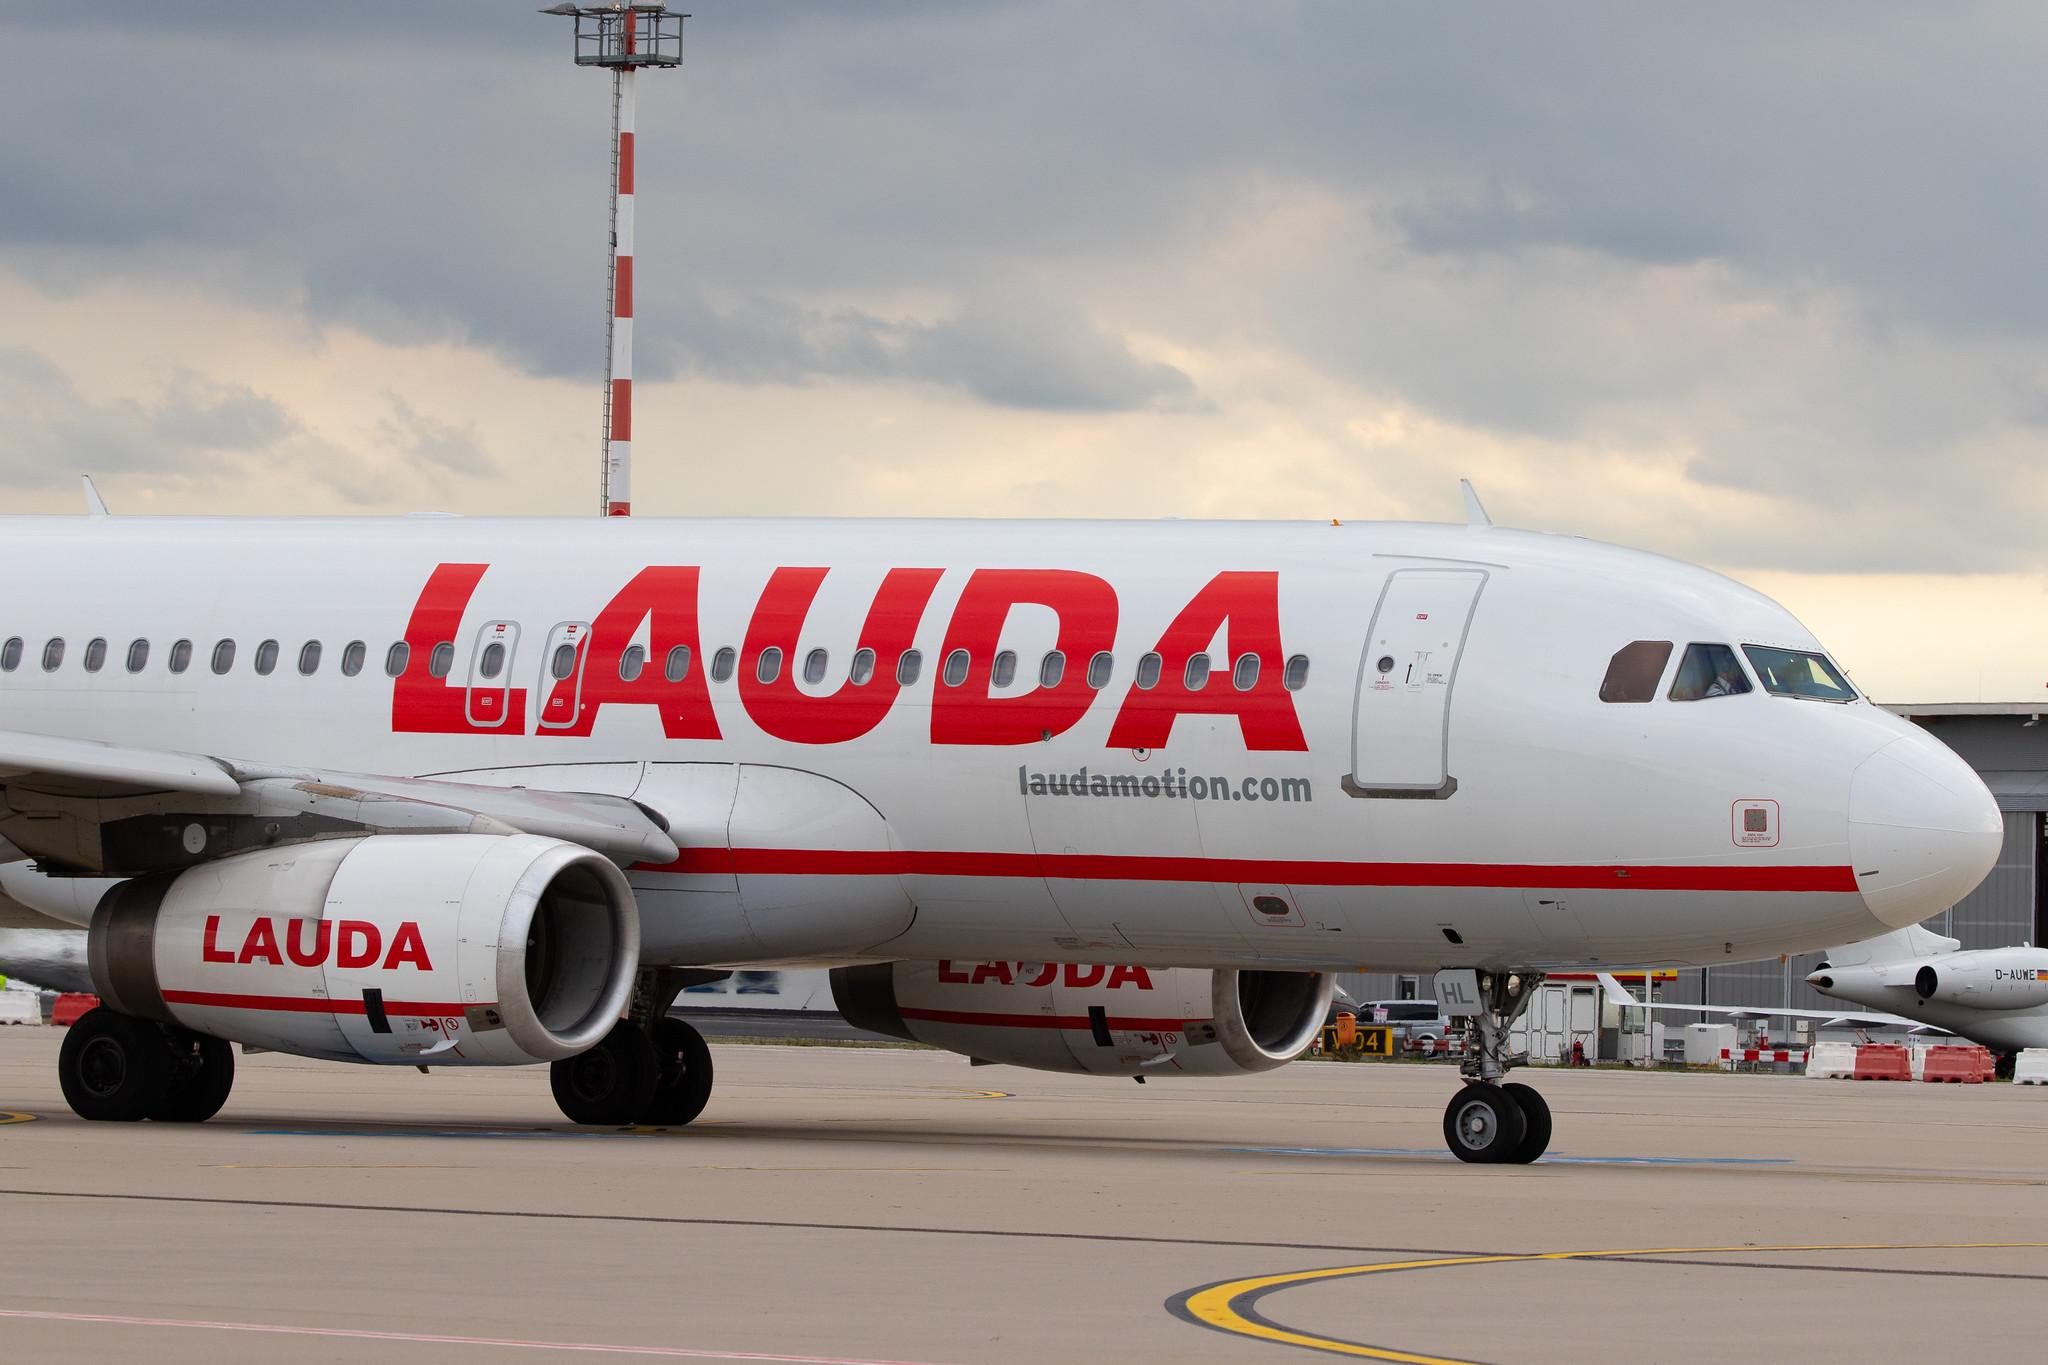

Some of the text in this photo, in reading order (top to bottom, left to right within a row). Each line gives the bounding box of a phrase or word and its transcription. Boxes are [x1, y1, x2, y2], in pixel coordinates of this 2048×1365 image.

[391, 562, 1310, 752] LAUDA
[1018, 764, 1313, 802] laudamotion.com
[203, 914, 434, 972] LAUDA
[1441, 982, 1474, 1004] HL
[1995, 969, 2036, 981] D-AUWE
